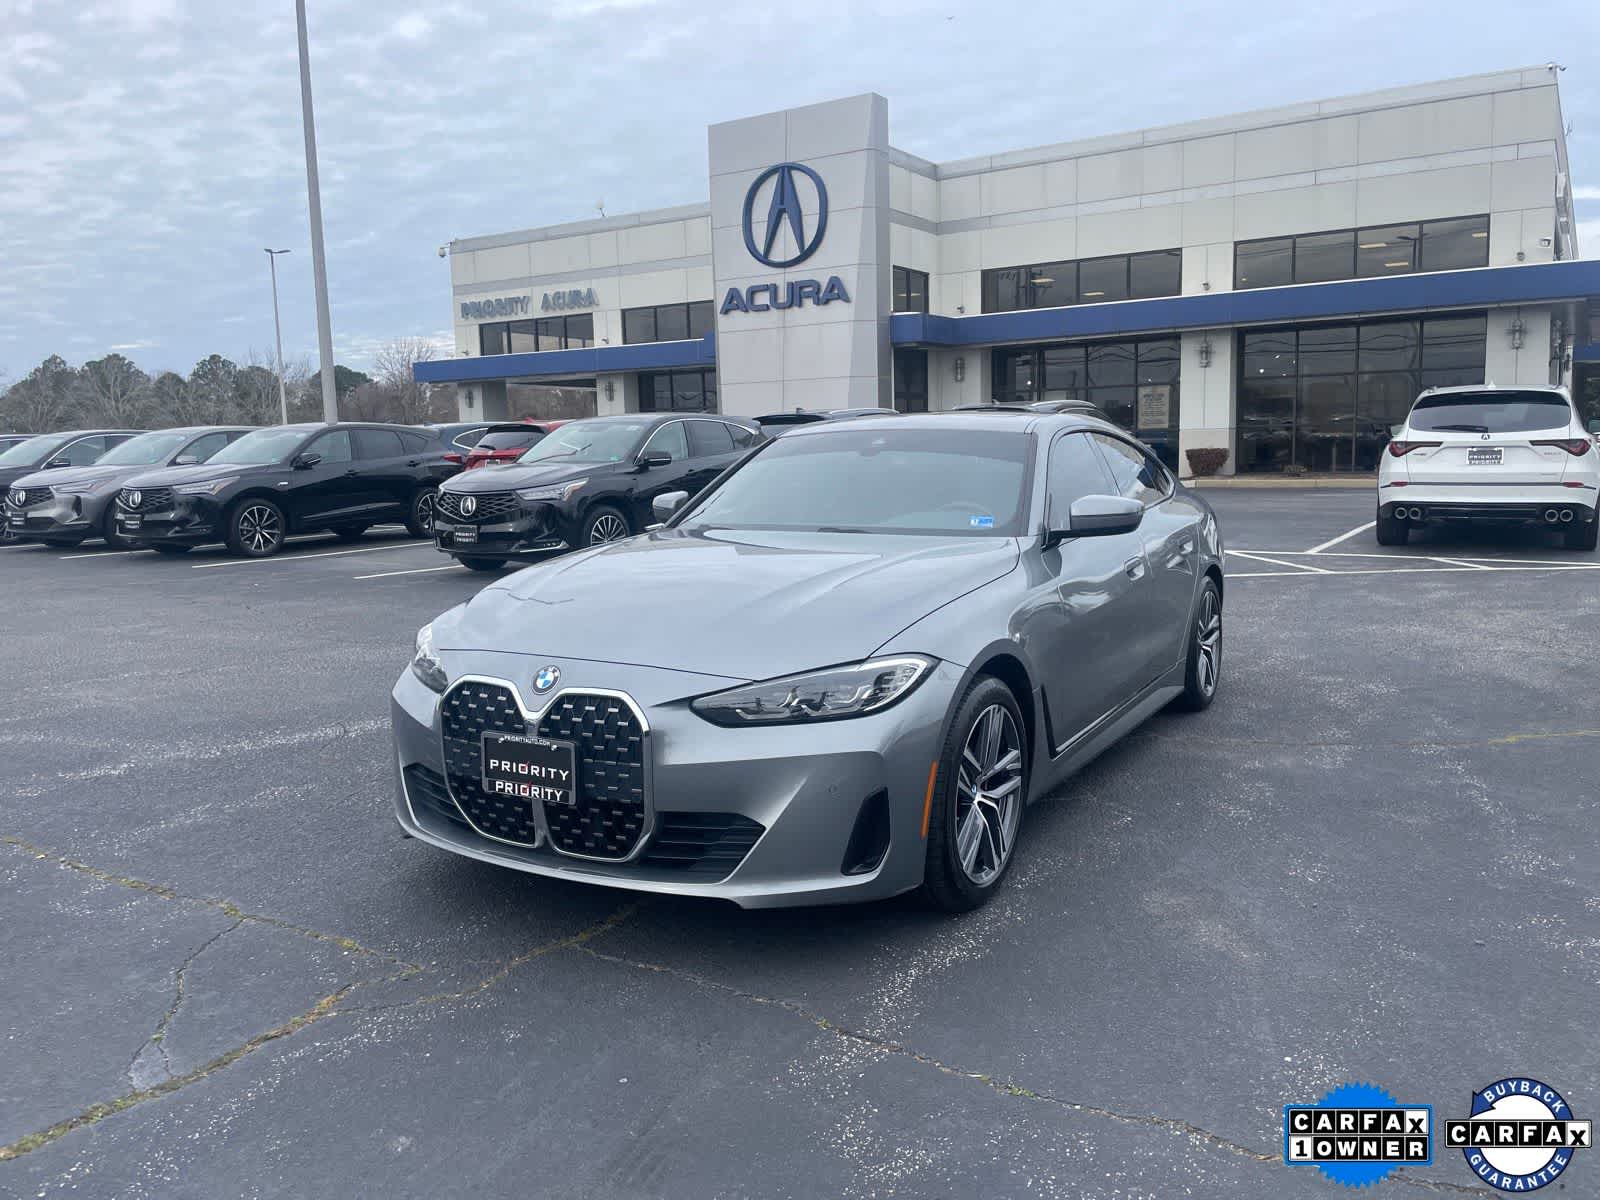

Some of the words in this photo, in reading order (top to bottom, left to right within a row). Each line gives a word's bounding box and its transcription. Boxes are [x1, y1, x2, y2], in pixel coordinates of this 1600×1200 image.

[461, 295, 531, 319] PRIORITY
[541, 288, 600, 311] ACURA
[719, 275, 850, 315] ACURA
[489, 759, 569, 781] PRIORITY
[495, 781, 563, 801] PRIORITY
